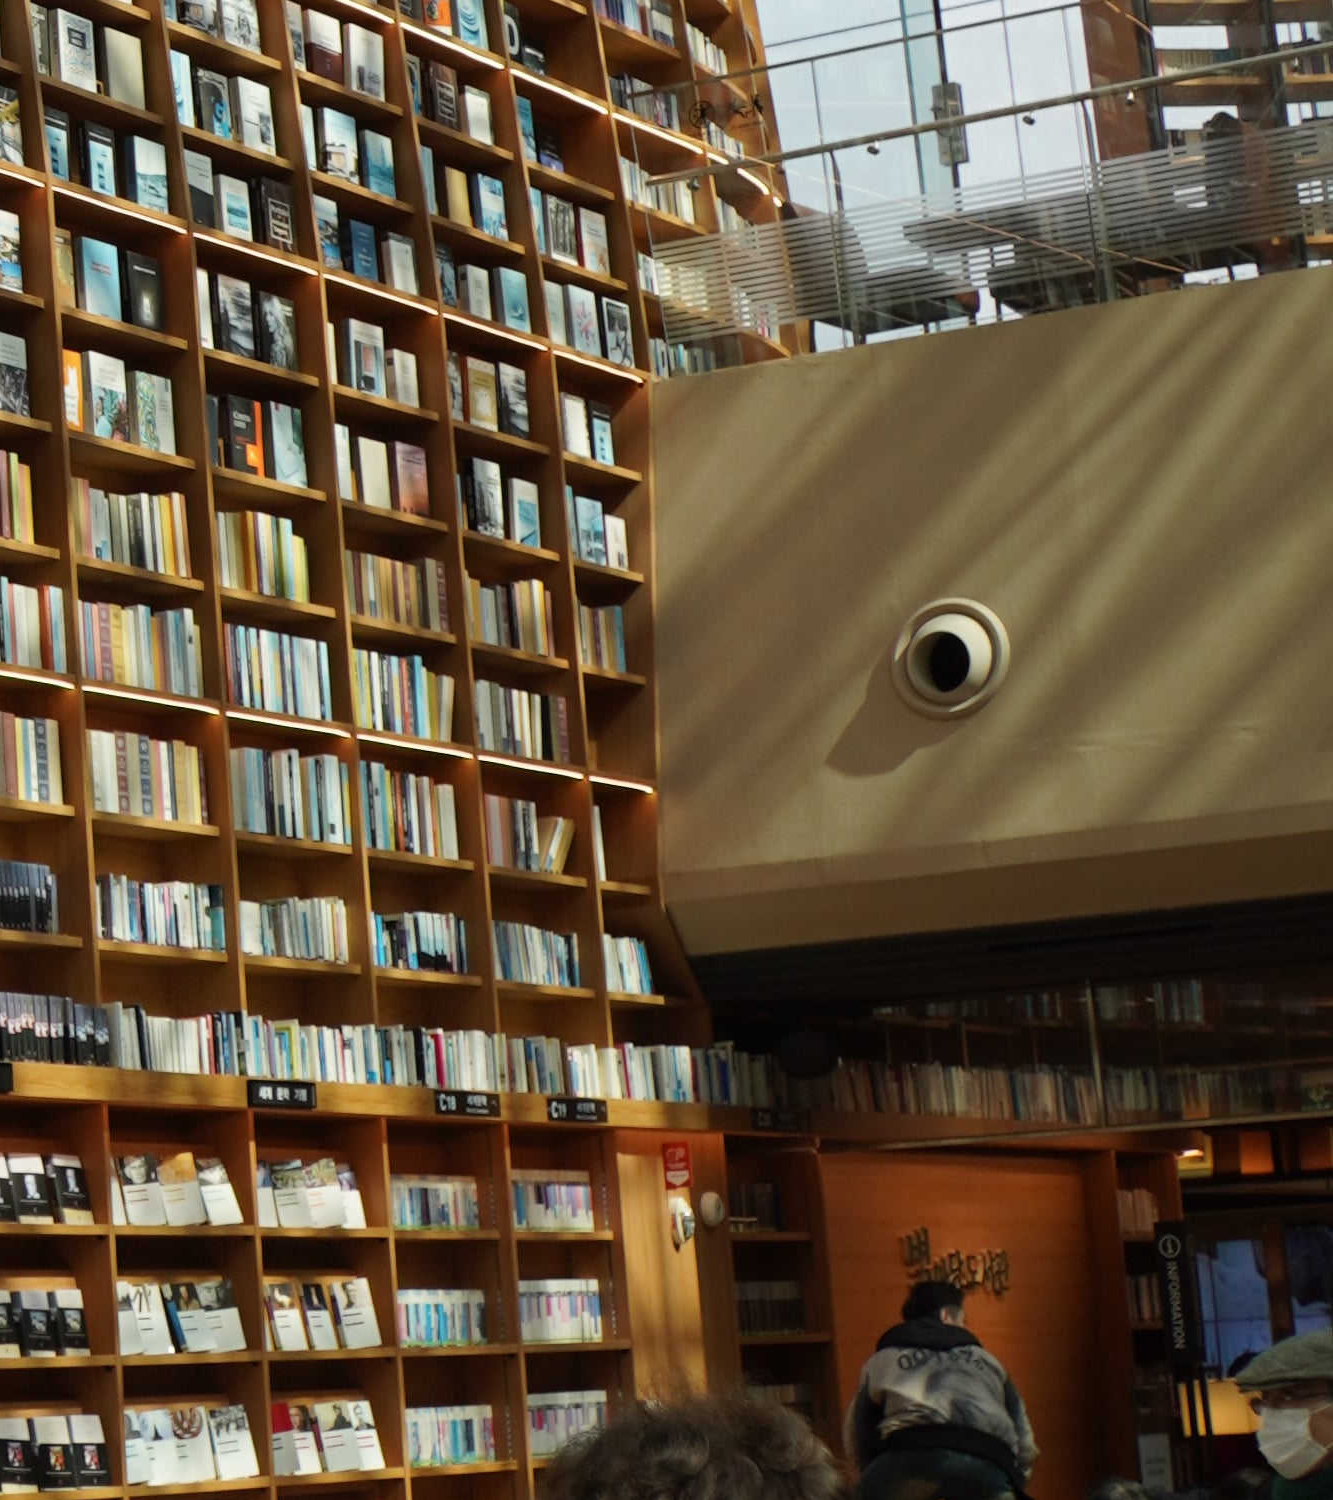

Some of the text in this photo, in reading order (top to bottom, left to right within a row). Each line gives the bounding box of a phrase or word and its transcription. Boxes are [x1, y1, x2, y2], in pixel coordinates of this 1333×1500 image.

[440, 1093, 457, 1111] C18
[550, 1101, 567, 1118] C19
[1166, 1261, 1185, 1350] INFORMATION
